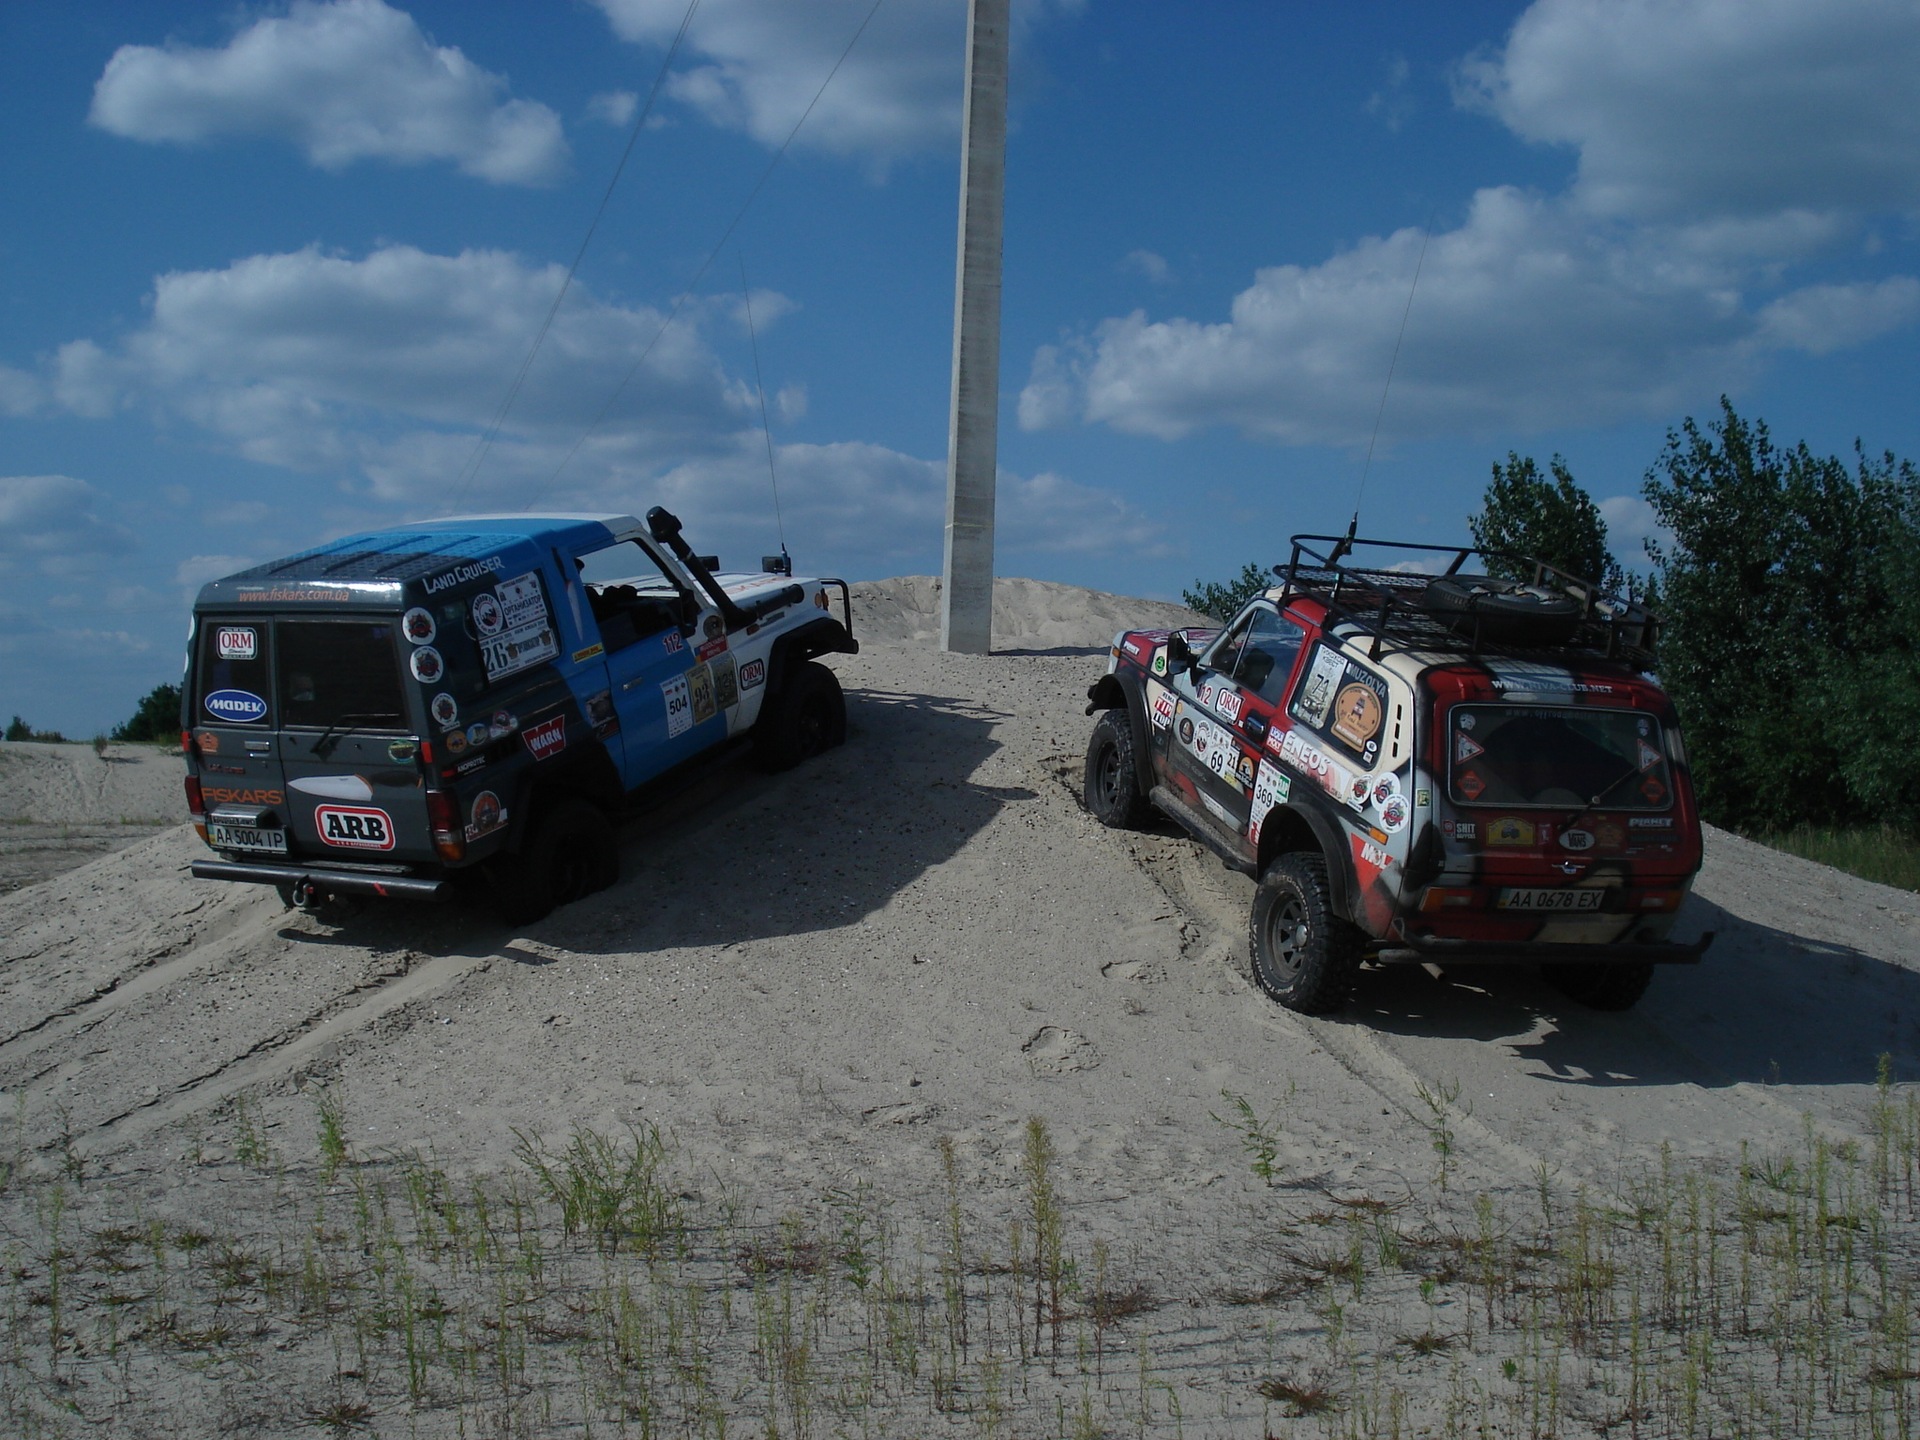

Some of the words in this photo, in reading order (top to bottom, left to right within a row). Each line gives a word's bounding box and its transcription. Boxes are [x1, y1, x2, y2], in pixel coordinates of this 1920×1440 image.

[422, 572, 456, 595] LAND
[454, 556, 506, 582] CRUISER
[239, 588, 349, 602] www.fiskars.com.ua
[221, 632, 252, 649] ORM
[663, 633, 682, 655] 112
[482, 642, 508, 672] 26
[742, 663, 762, 681] ORM
[695, 683, 710, 703] 93
[1219, 691, 1240, 714] ORM
[669, 694, 688, 715] 504
[1155, 699, 1172, 717] TIP
[1153, 711, 1171, 727] TOP
[530, 727, 562, 751] WARN
[1210, 750, 1224, 773] 69
[1227, 752, 1237, 769] 21
[1283, 733, 1329, 776] ENEOS
[201, 787, 283, 805] FISKARS
[1256, 784, 1272, 808] 369
[326, 813, 386, 842] ARB
[1456, 822, 1476, 834] SHIT
[216, 828, 234, 844] AA
[234, 829, 263, 846] 5004
[267, 833, 283, 848] IP
[1509, 891, 1532, 907] AA
[1536, 892, 1575, 907] 0678
[1577, 892, 1601, 907] EX
